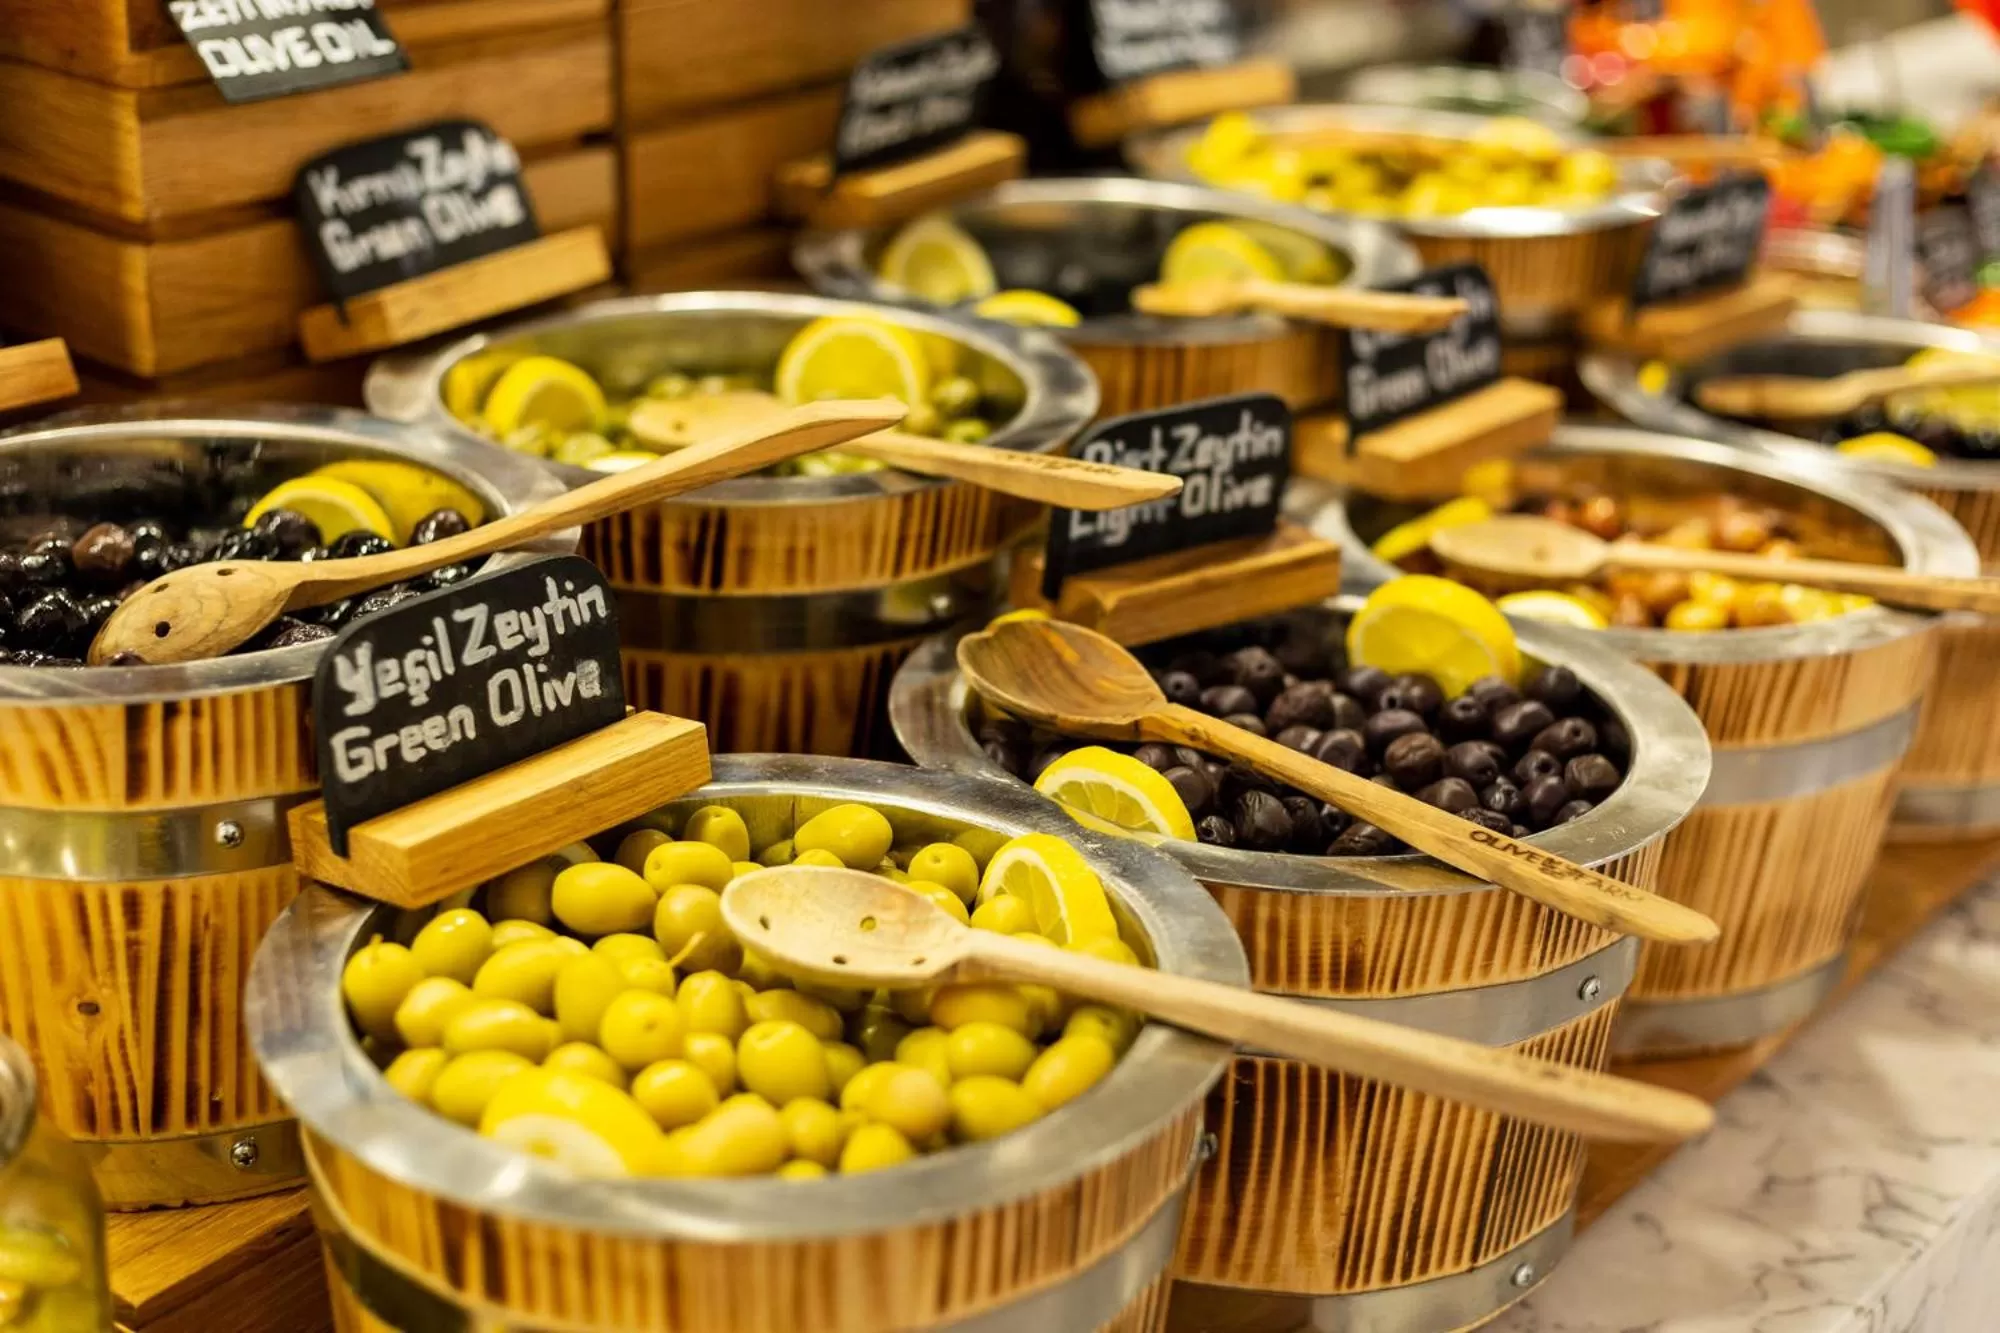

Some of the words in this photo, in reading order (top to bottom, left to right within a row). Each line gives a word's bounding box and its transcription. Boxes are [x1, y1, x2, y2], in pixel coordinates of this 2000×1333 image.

[1167, 409, 1284, 480] Zeytin
[1181, 470, 1274, 518] Olive
[453, 575, 607, 667] Zeytin
[329, 704, 477, 784] Green
[487, 660, 602, 727] Olive
